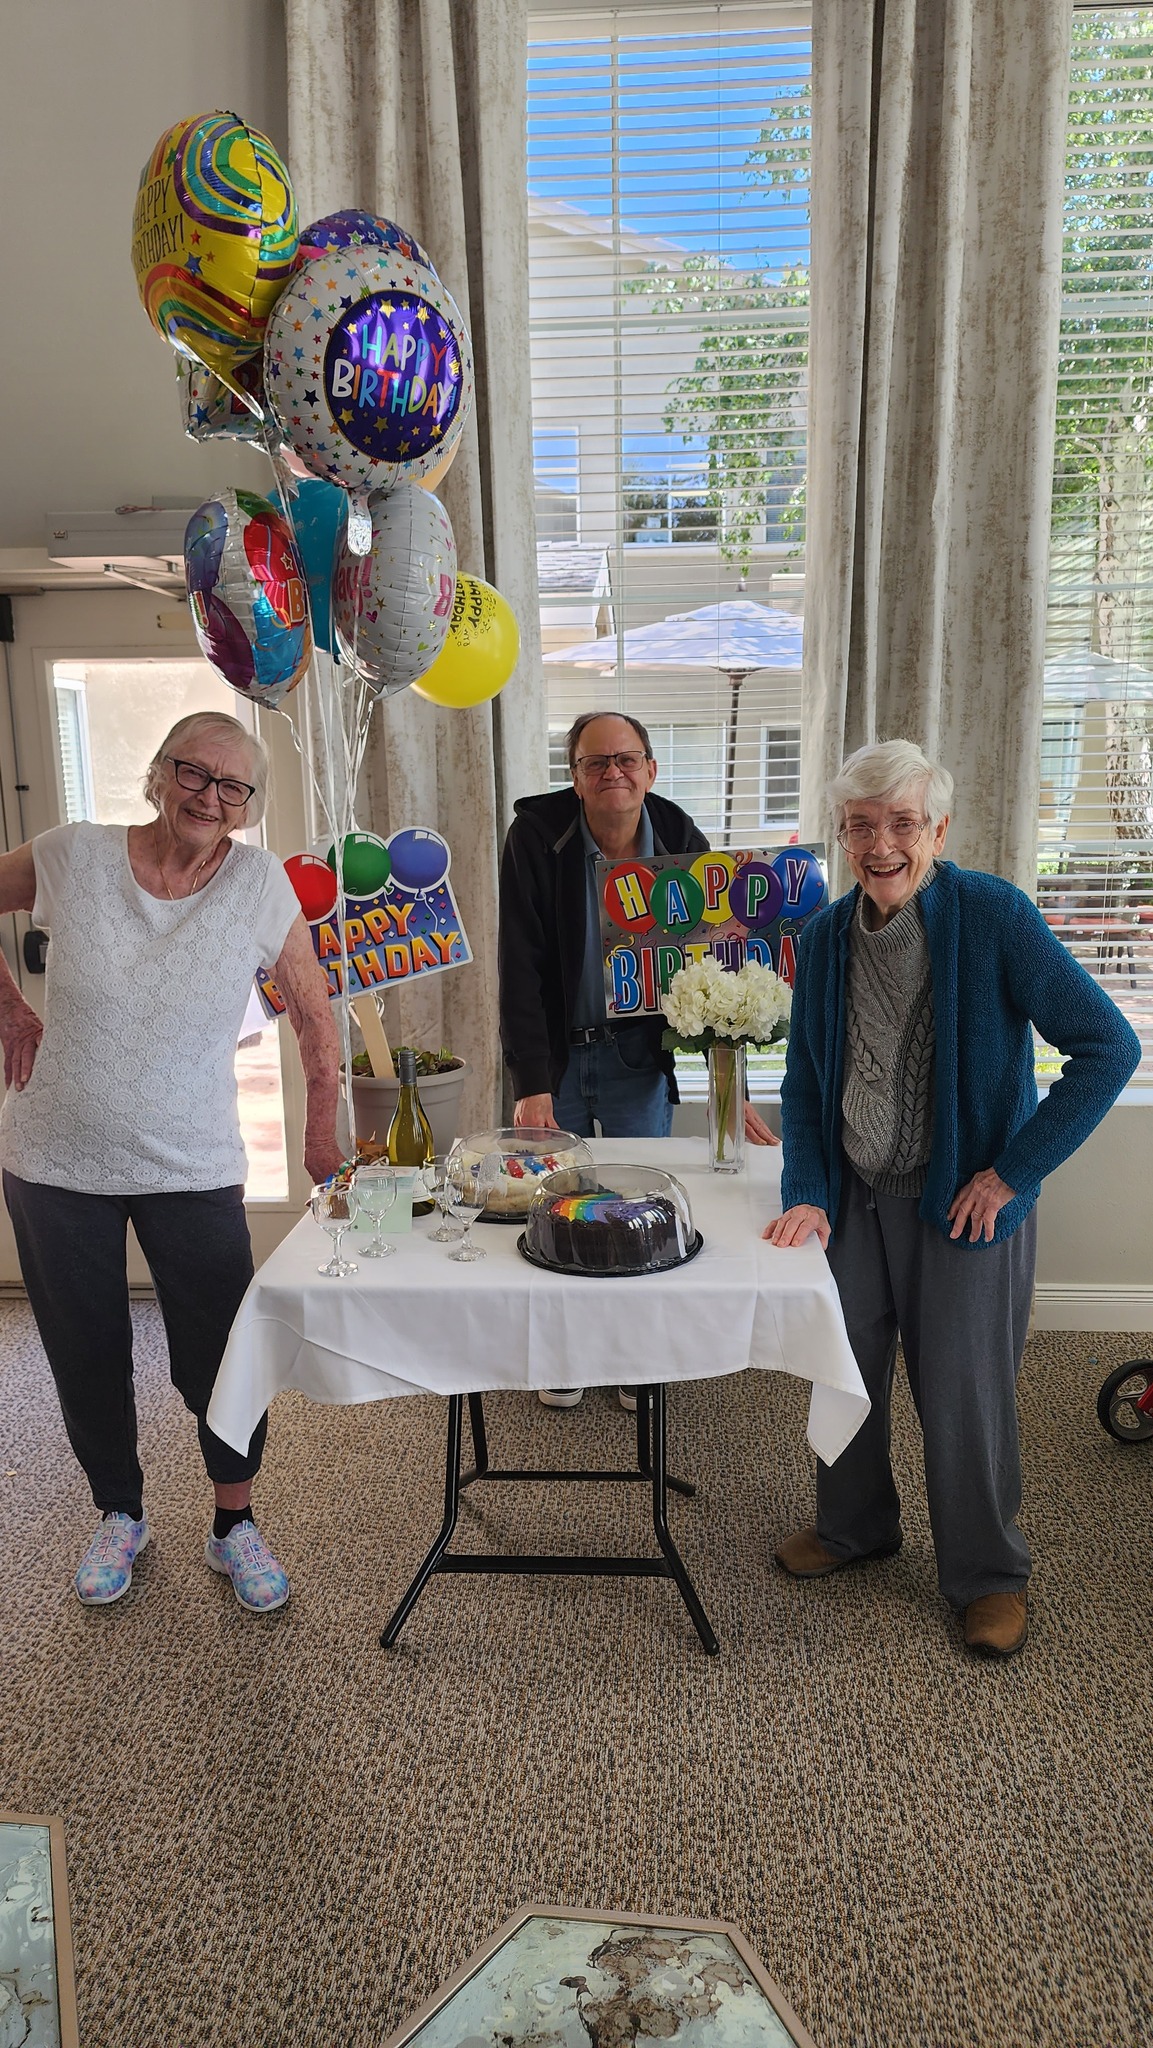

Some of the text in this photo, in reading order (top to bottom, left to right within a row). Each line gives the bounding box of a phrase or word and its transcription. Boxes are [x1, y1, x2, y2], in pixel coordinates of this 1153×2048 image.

[134, 174, 172, 234] HAPPY
[132, 212, 186, 273] IRTHDAY!
[362, 323, 448, 376] HAPPY
[331, 358, 457, 422] BIRTHDAY!
[449, 579, 466, 633] RTHDAY
[464, 579, 483, 628] HAPPY
[614, 858, 808, 926] HAPPY
[317, 902, 416, 960] APPY
[261, 930, 460, 1014] BTHDAY
